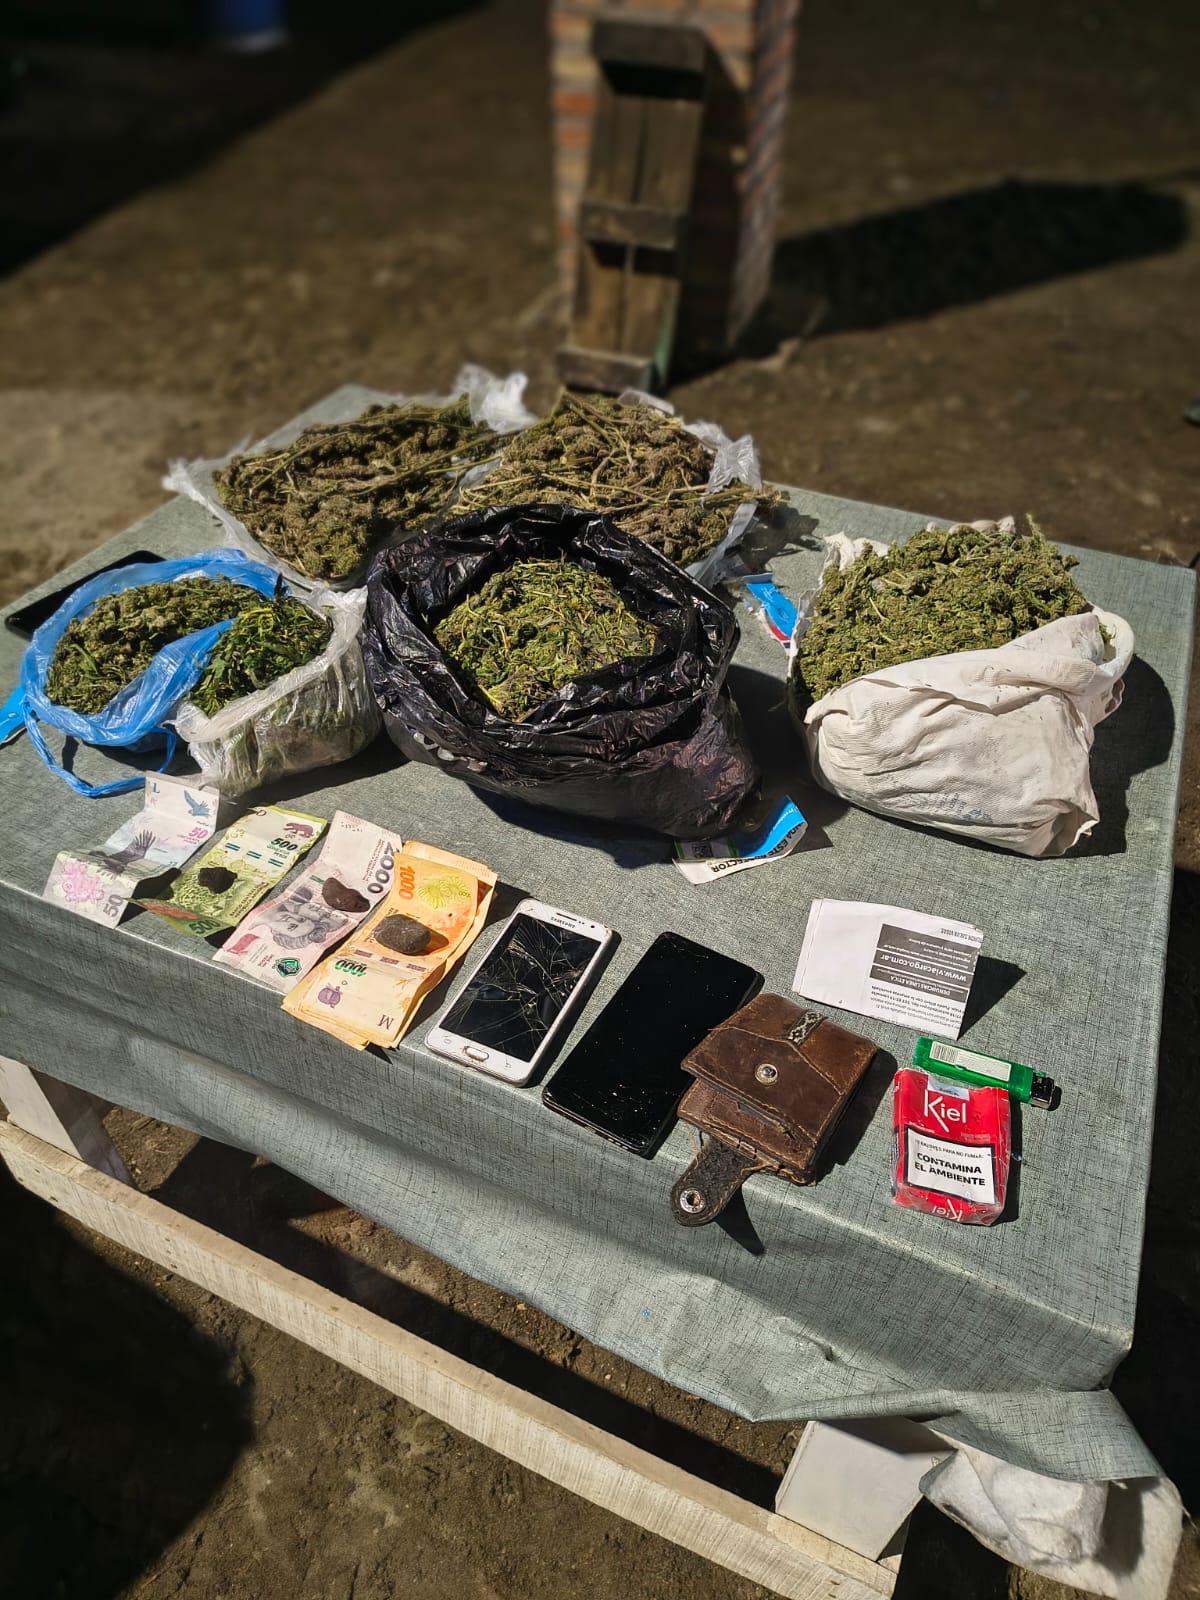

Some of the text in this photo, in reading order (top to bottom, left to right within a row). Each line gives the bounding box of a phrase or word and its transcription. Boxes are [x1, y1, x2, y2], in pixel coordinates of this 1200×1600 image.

[188, 826, 209, 840] 50
[270, 837, 298, 851] 500
[399, 865, 416, 900] 1000
[102, 894, 124, 918] 50
[188, 919, 221, 934] 500
[551, 916, 576, 929] SAMSUNG
[880, 954, 967, 982] www.viacargo.com.ar
[923, 1089, 967, 1133] Kiel
[914, 1162, 986, 1186] EL AMBIENTE
[917, 1152, 982, 1174] CONTAMINA
[931, 1198, 963, 1222] Kiel
